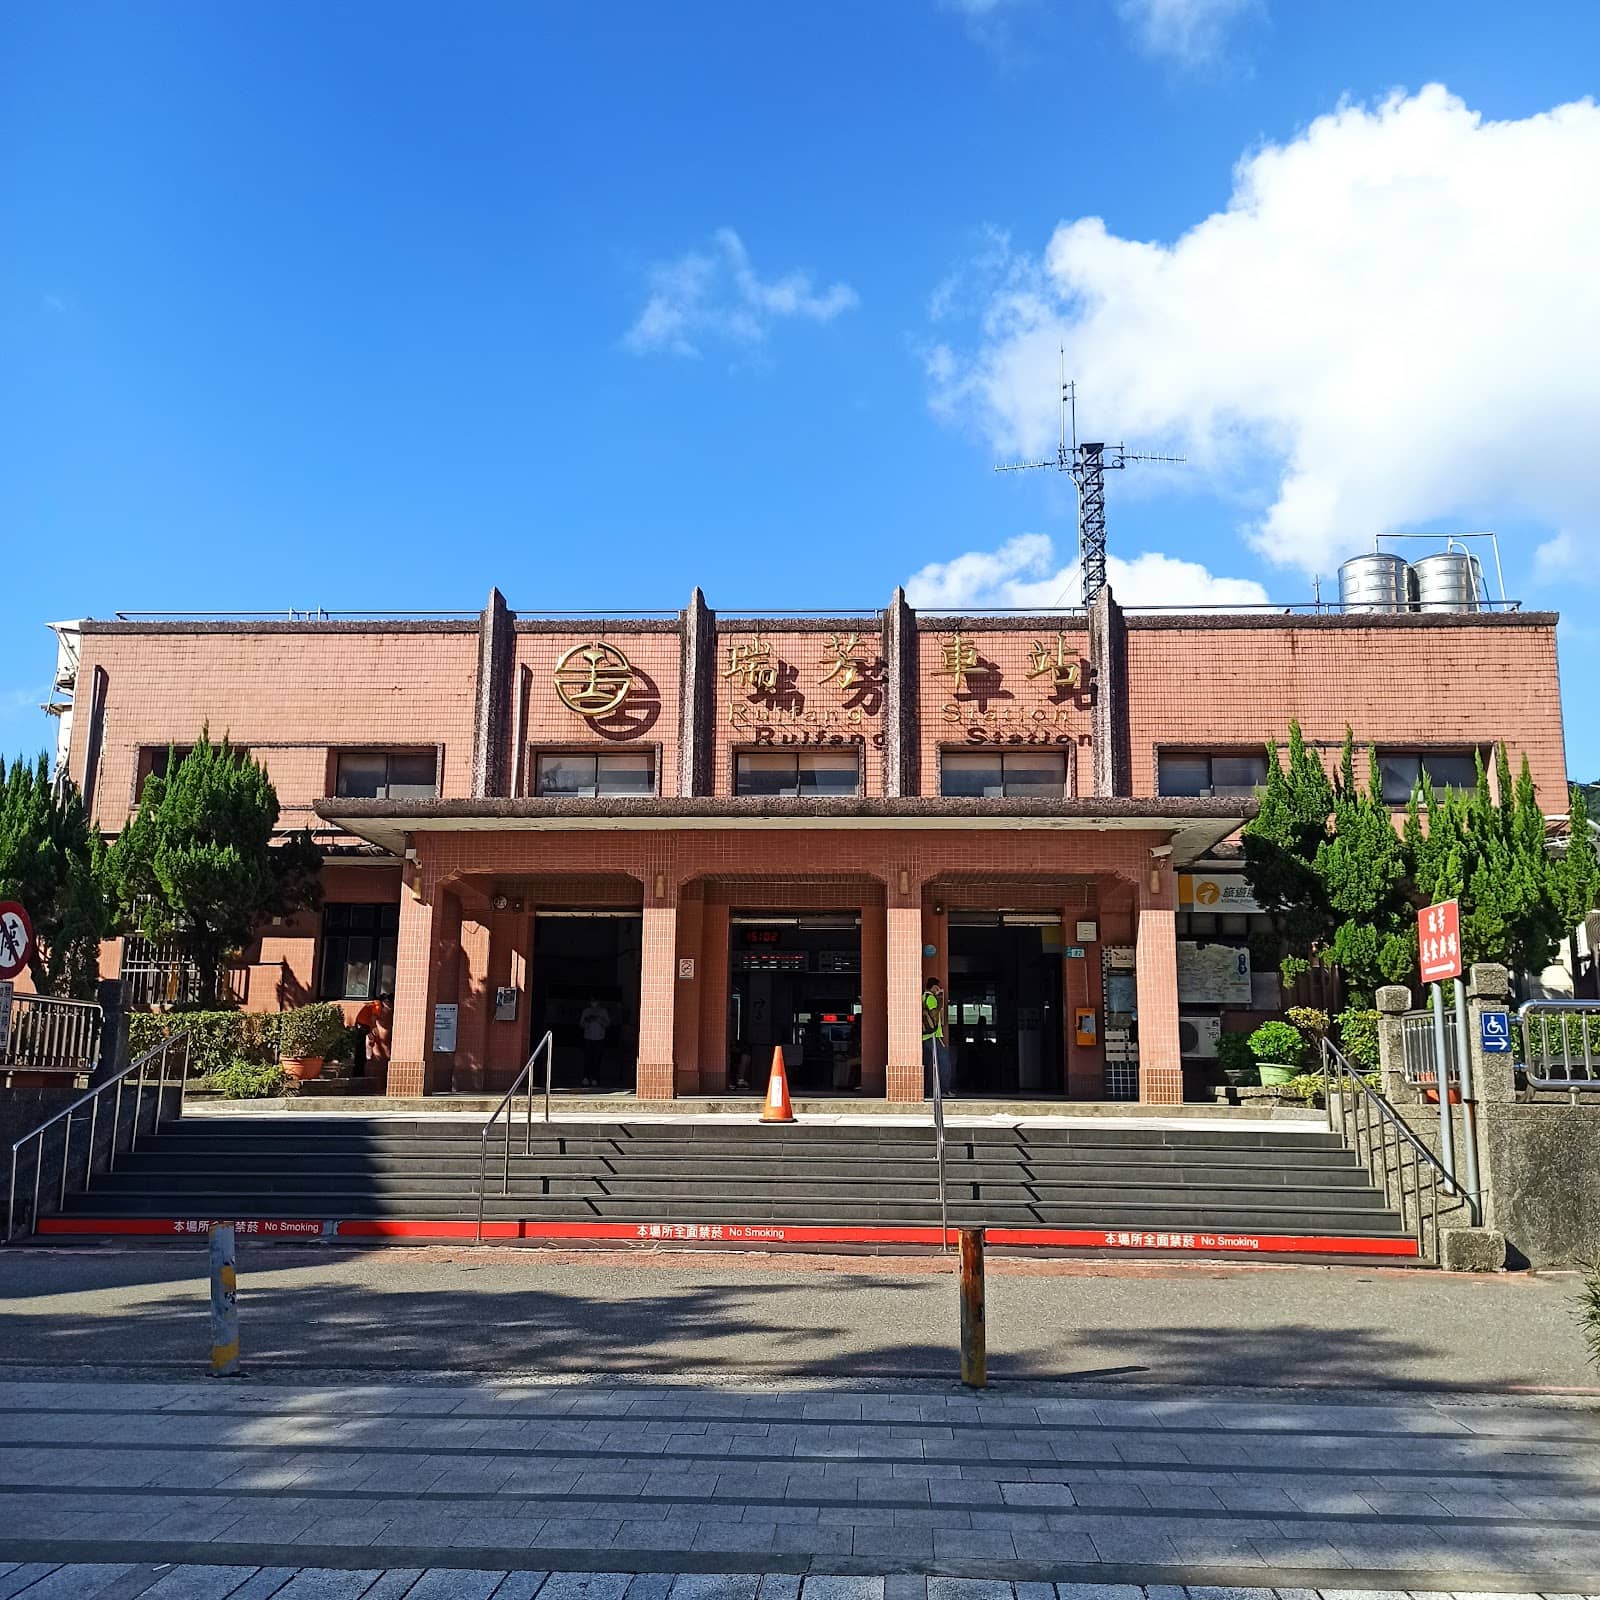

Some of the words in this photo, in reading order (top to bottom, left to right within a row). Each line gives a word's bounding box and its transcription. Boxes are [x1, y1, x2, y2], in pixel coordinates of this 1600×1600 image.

[721, 635, 868, 688] 瑞芳
[930, 632, 1080, 688] 車站
[728, 702, 864, 725] Ruifang
[942, 703, 1069, 723] Station
[173, 1220, 259, 1233] 本場所禁菸
[264, 1222, 278, 1232] No
[280, 1222, 319, 1234] Smoking
[637, 1225, 723, 1239] 本場所全面禁菸
[729, 1227, 742, 1237] No
[744, 1228, 785, 1239] Smoking
[1104, 1232, 1195, 1248] 本場所全面禁菸
[1200, 1236, 1216, 1246] No
[1217, 1236, 1259, 1249] Smoking
